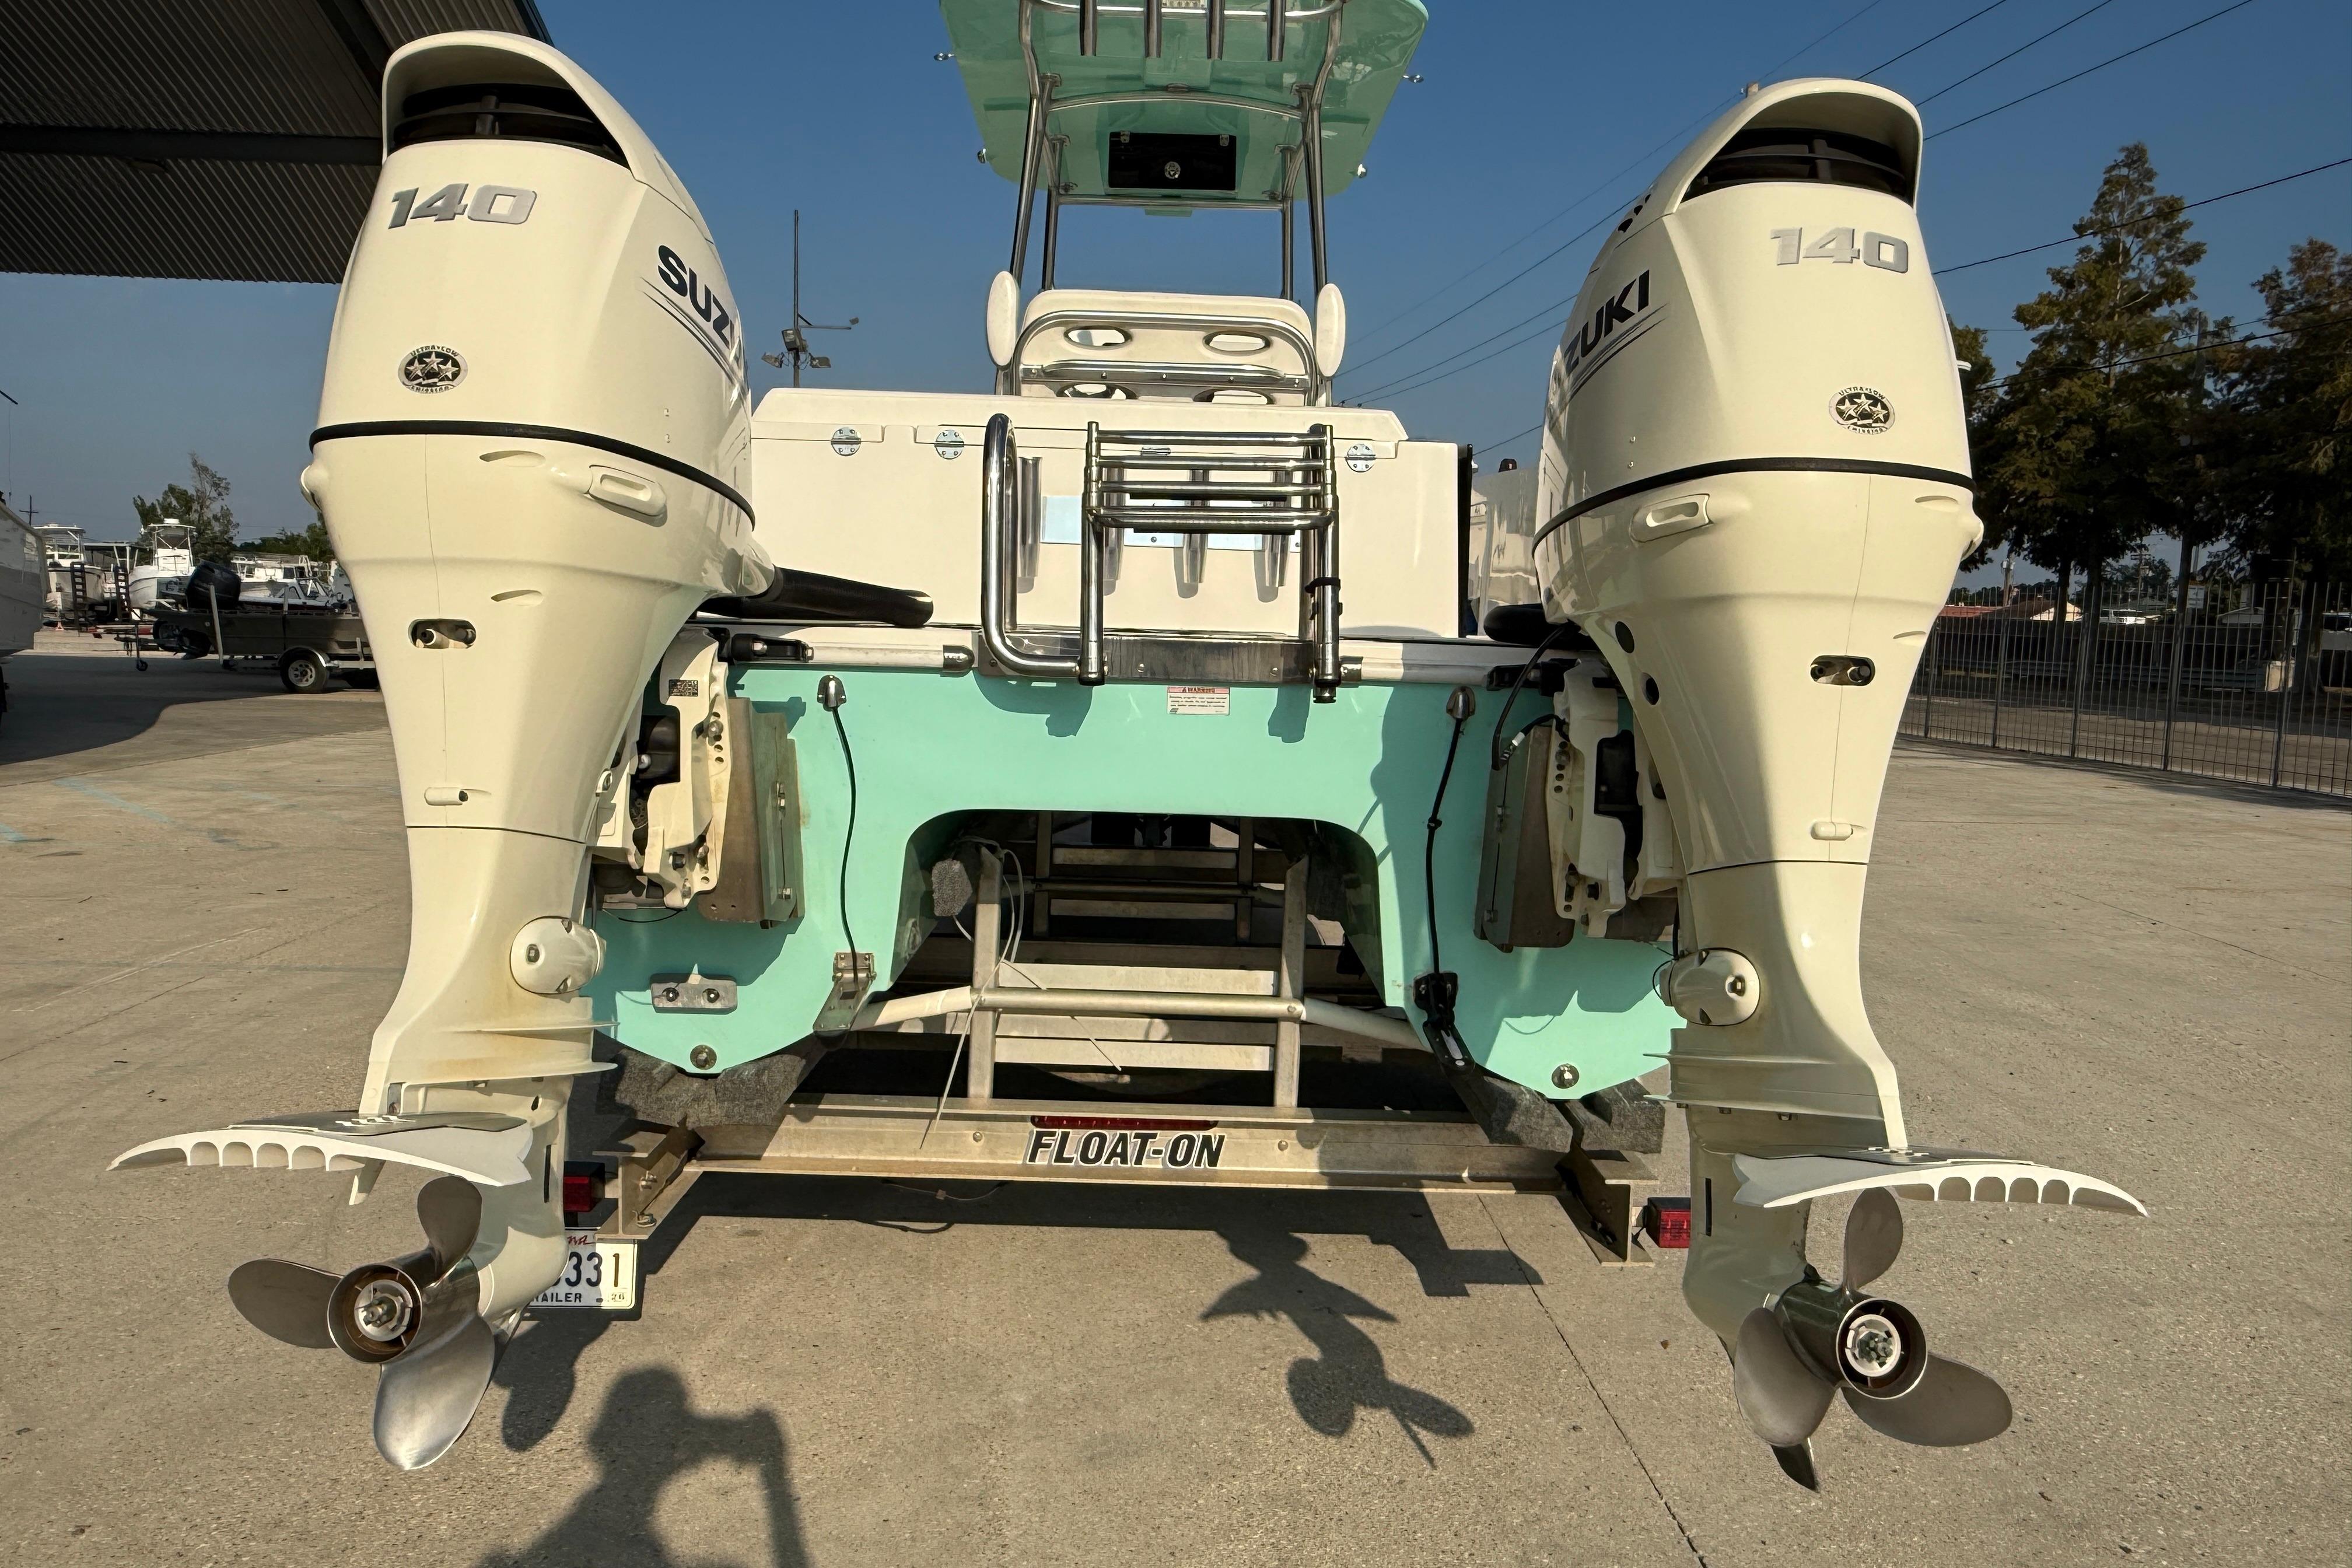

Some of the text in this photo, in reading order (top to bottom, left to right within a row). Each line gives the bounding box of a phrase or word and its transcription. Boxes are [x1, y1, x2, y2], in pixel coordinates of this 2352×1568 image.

[387, 183, 538, 229] 140
[1770, 226, 1909, 274] 140
[657, 244, 735, 353] SUZ
[1563, 269, 1650, 377] ZUKI
[1027, 1128, 1227, 1169] FLOAT-ON
[552, 1251, 621, 1287] 331
[533, 1292, 582, 1303] AILER
